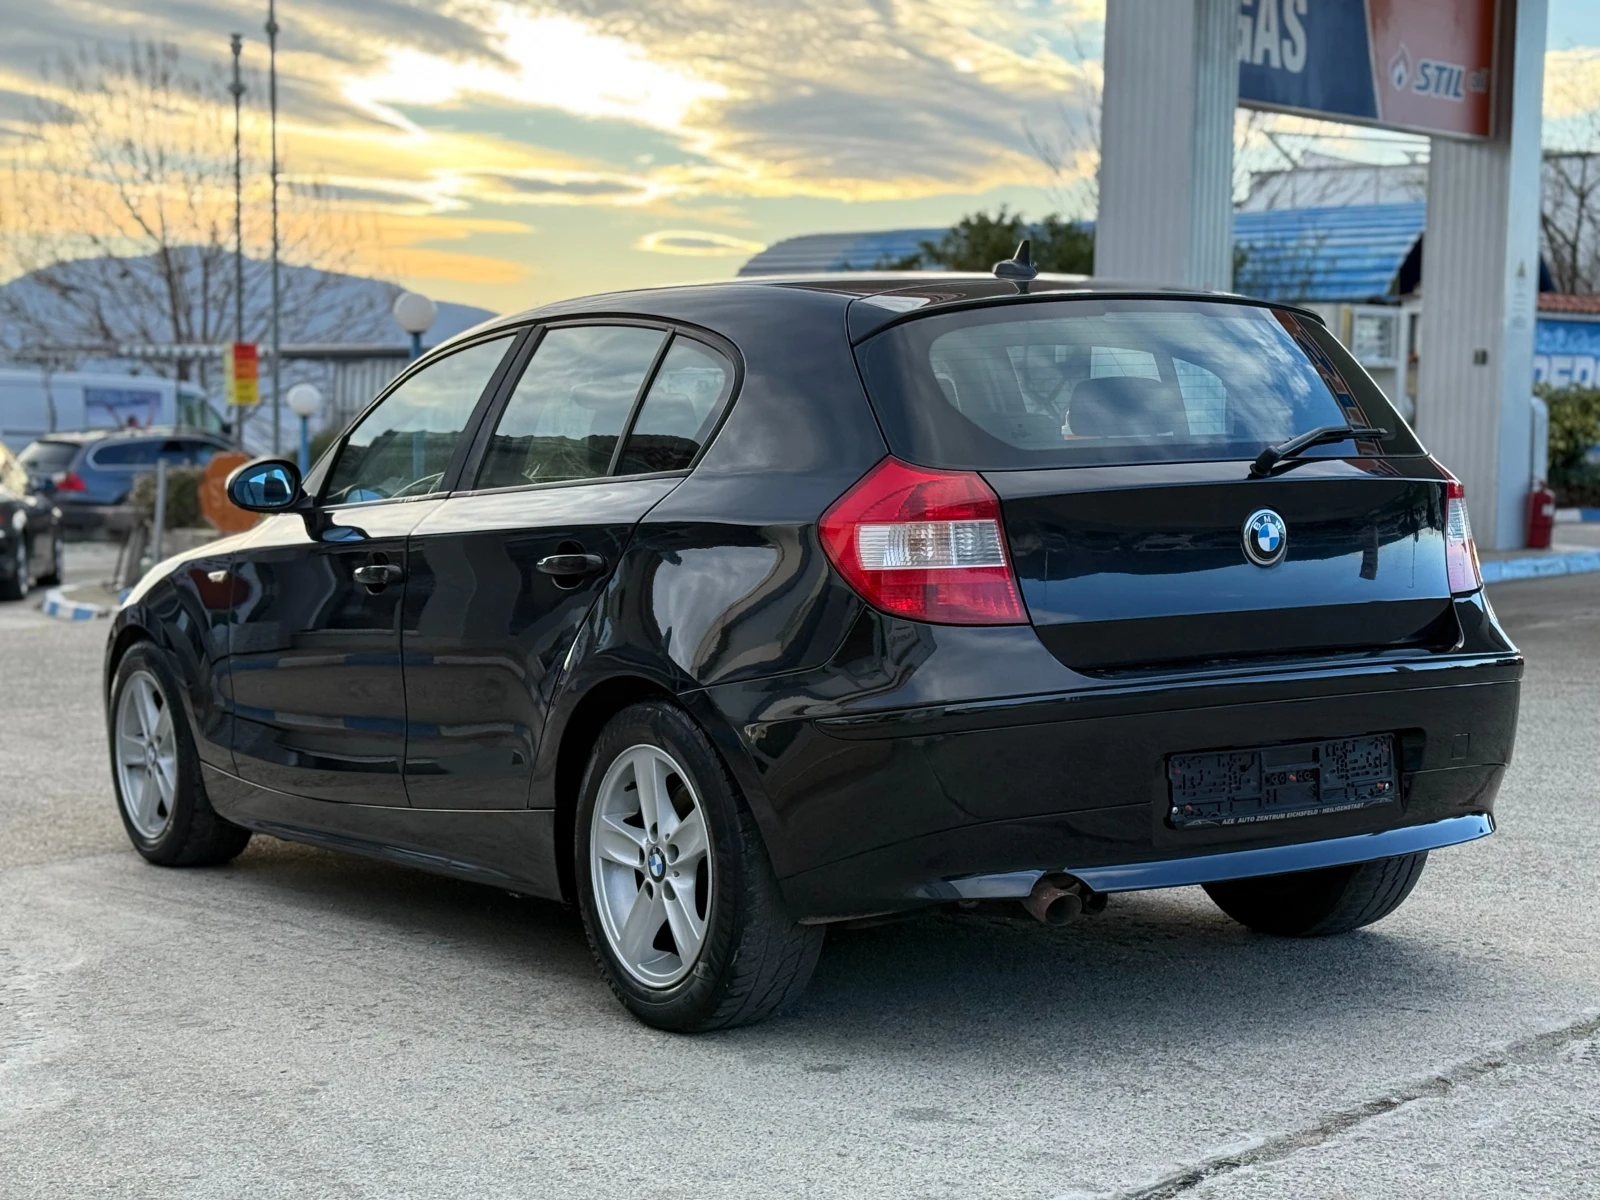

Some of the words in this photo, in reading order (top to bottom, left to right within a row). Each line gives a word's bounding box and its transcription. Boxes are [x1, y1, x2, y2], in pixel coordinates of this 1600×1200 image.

[1414, 60, 1465, 100] STIL
[1238, 816, 1255, 824] AUTO
[1256, 813, 1286, 822] ZENTRUM
[1287, 809, 1318, 818] EICHSFELD
[1322, 802, 1364, 814] HEILIGENSTADT
